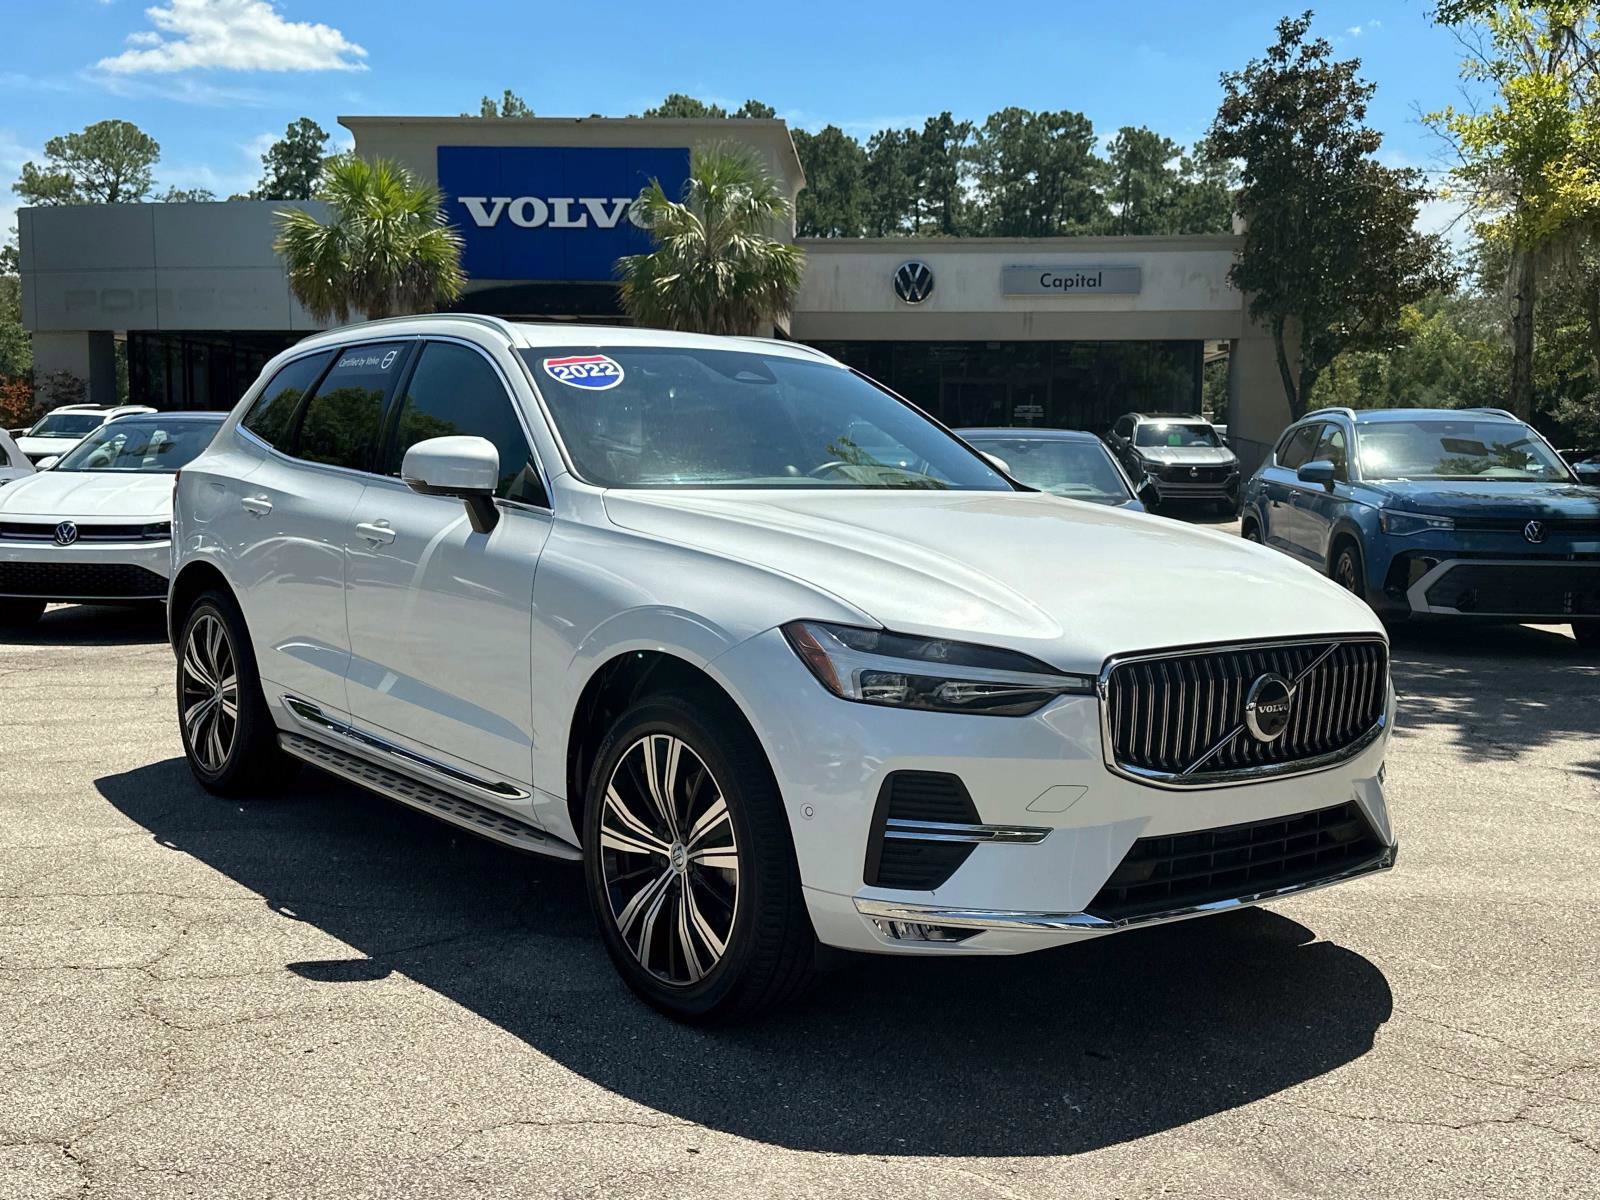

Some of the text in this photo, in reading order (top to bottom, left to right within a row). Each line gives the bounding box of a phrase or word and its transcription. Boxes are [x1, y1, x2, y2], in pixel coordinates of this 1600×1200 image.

[1040, 272, 1102, 291] Capital
[553, 363, 620, 380] 2022
[1258, 704, 1288, 714] VOLVO
